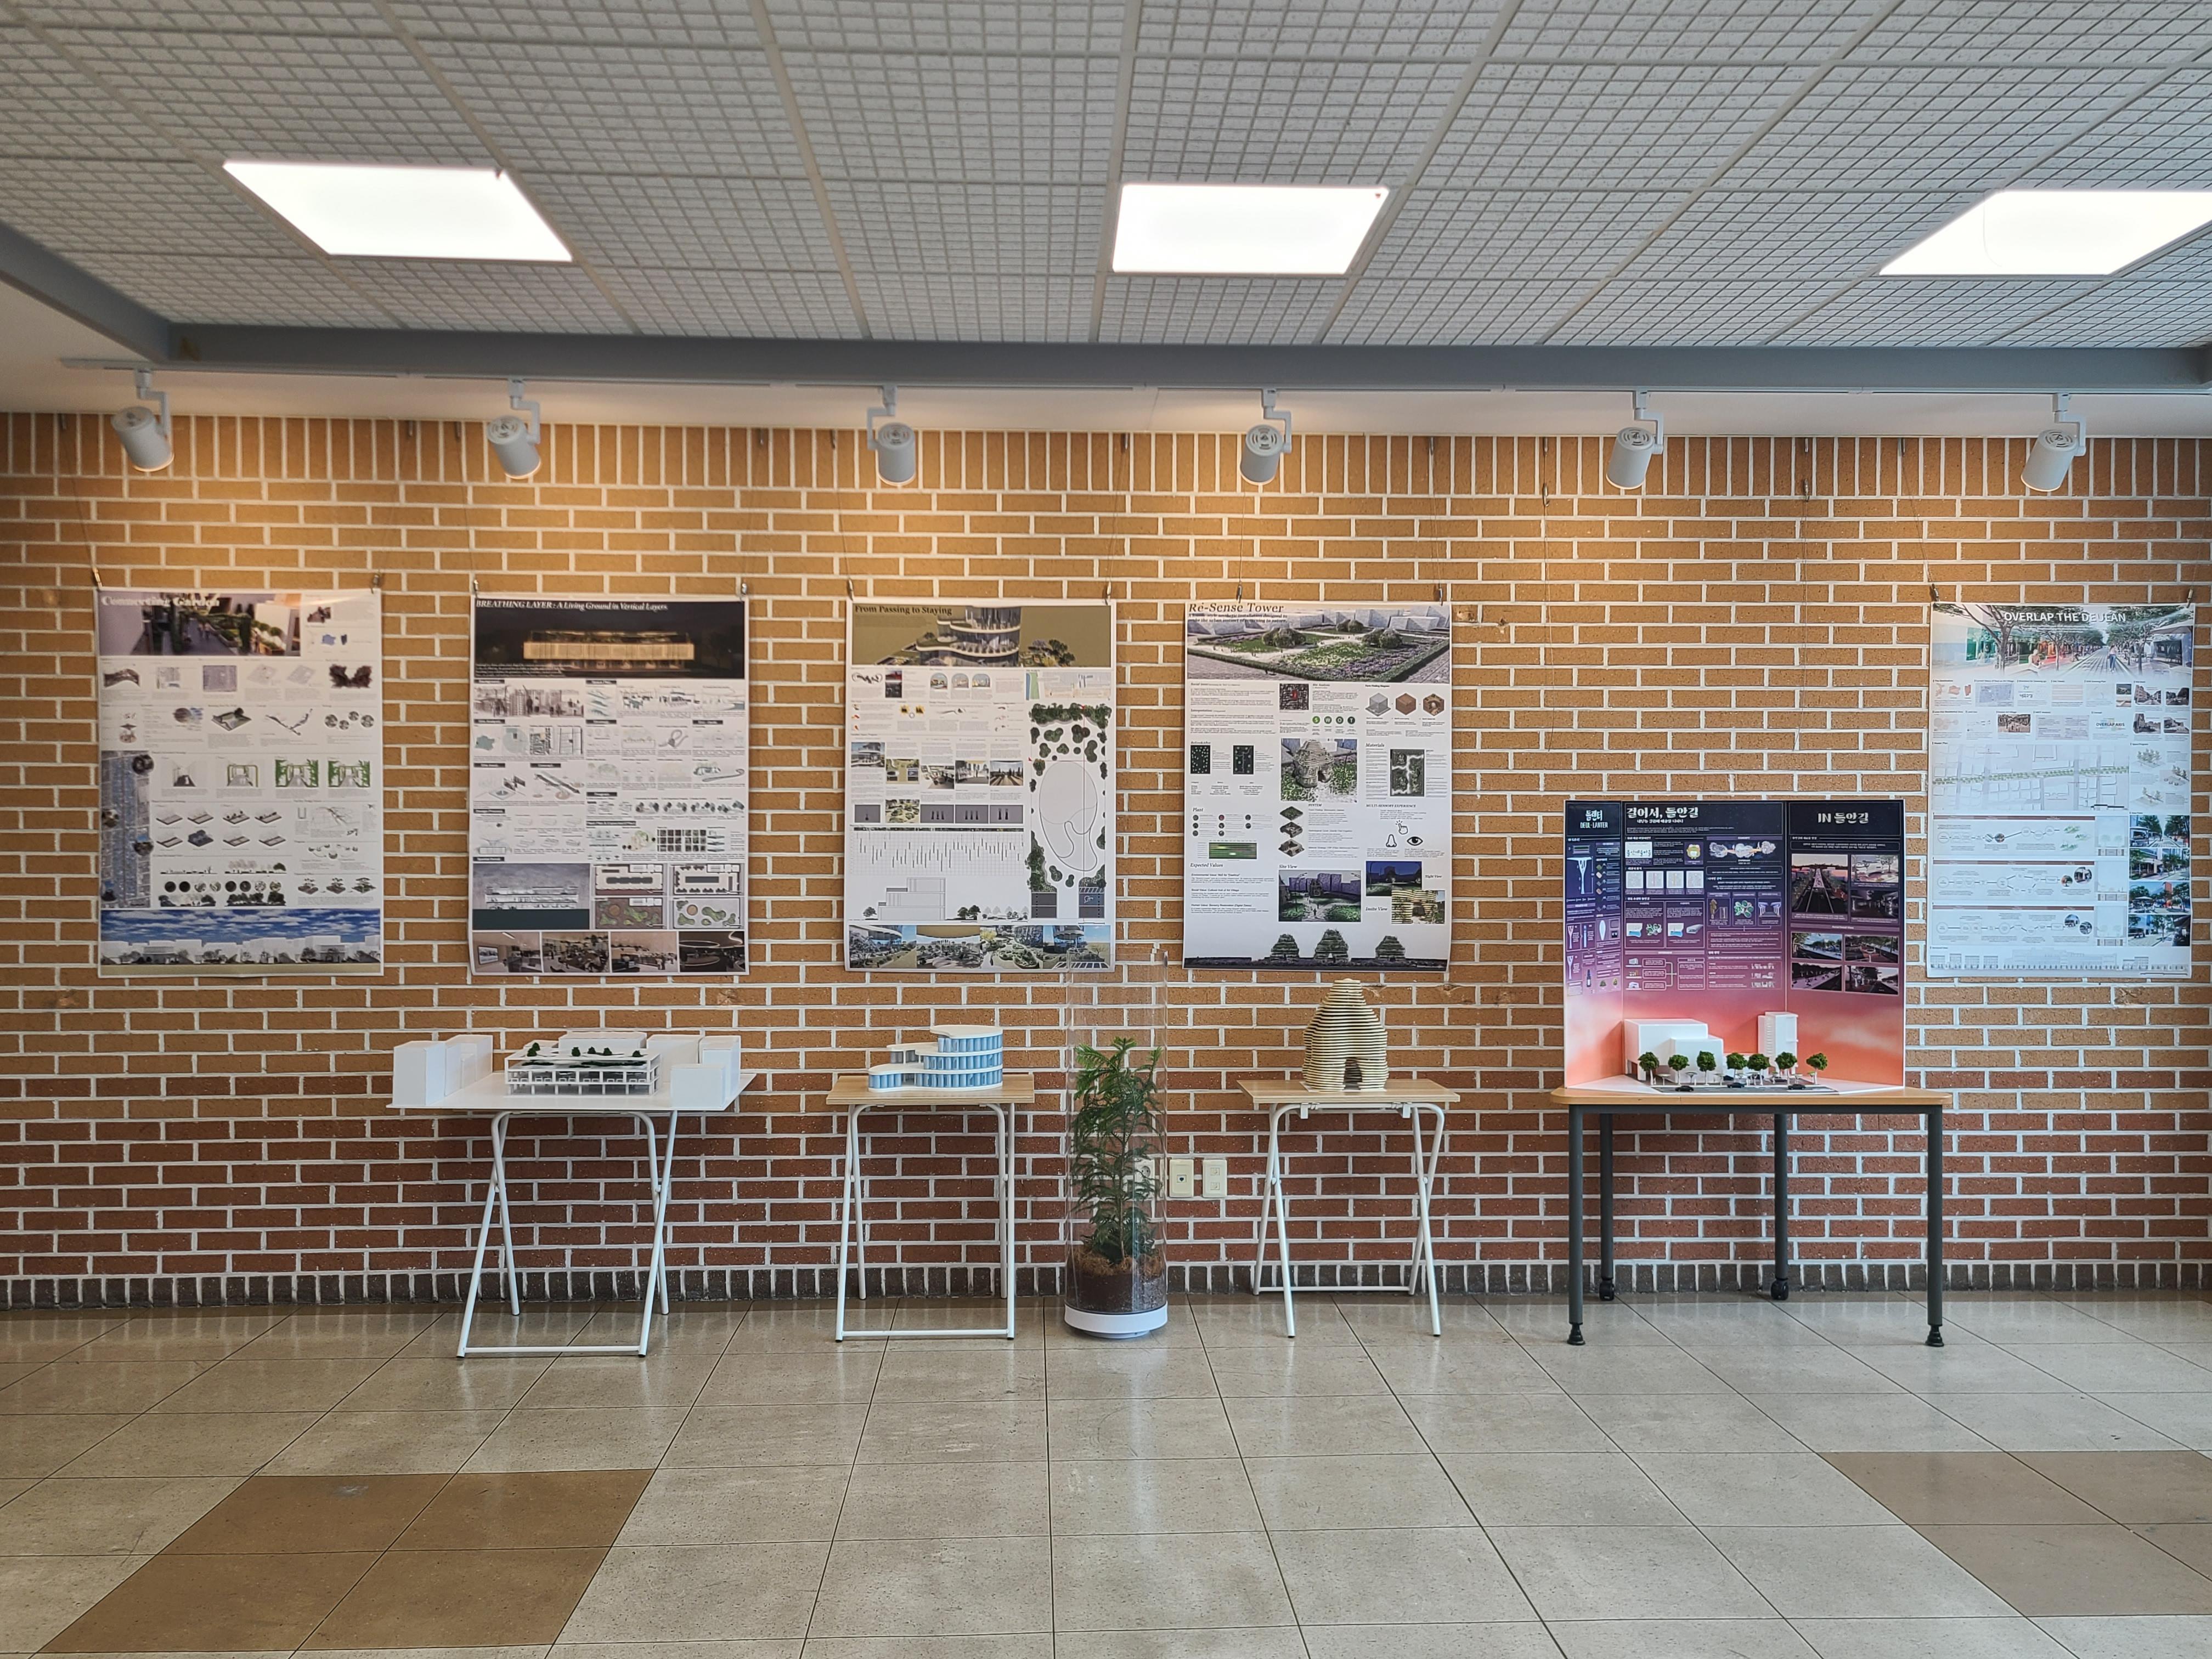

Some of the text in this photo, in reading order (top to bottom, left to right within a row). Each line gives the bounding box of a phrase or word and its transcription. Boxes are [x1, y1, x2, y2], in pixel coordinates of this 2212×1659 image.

[476, 600, 526, 608] BREATHING
[565, 602, 585, 612] Living
[620, 602, 645, 611] Vertical
[646, 603, 668, 612] Layers
[879, 605, 910, 614] Passing
[921, 606, 952, 616] Staying
[1247, 603, 1284, 612] Tower
[2004, 612, 2126, 622] OVERLAP THE DEULAN
[1626, 806, 1699, 819] 걸어서, 들안길
[1818, 812, 1869, 824] IN 들안길
